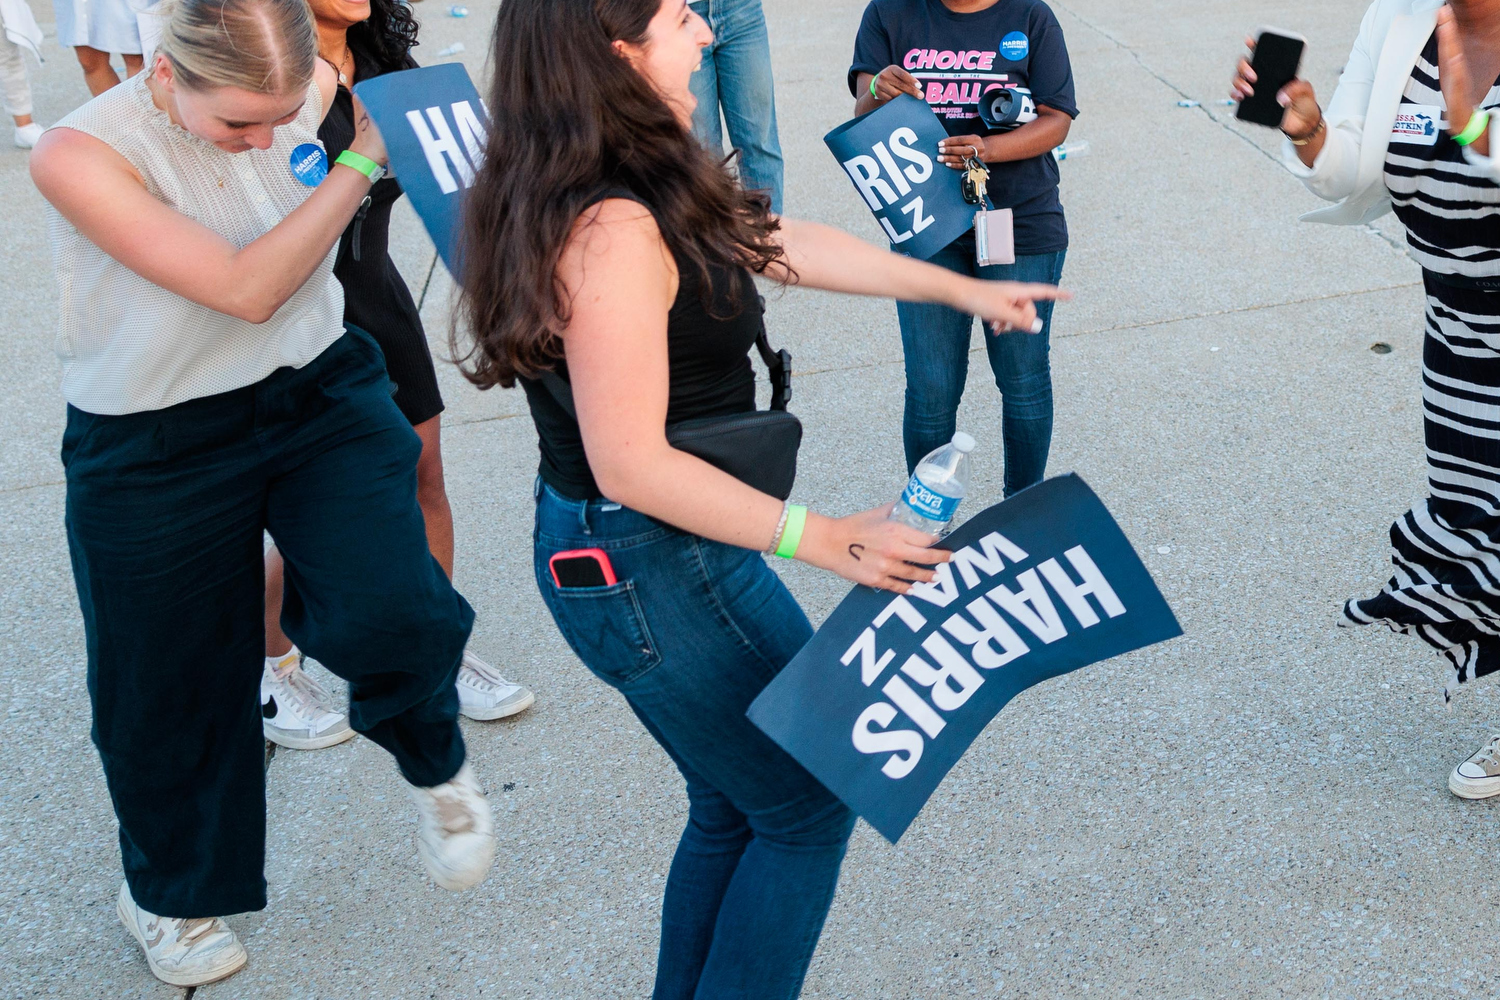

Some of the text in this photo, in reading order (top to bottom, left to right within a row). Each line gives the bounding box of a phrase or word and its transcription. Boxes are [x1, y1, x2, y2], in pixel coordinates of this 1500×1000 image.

[903, 48, 997, 71] CHOICE
[1393, 122, 1423, 130] OTKIN
[1397, 114, 1416, 122] ISSA
[294, 150, 321, 174] HARRIS
[843, 127, 934, 212] RIS
[880, 195, 936, 244] LZ
[840, 531, 1029, 687] WALZ
[852, 544, 1127, 779] HARRIS
